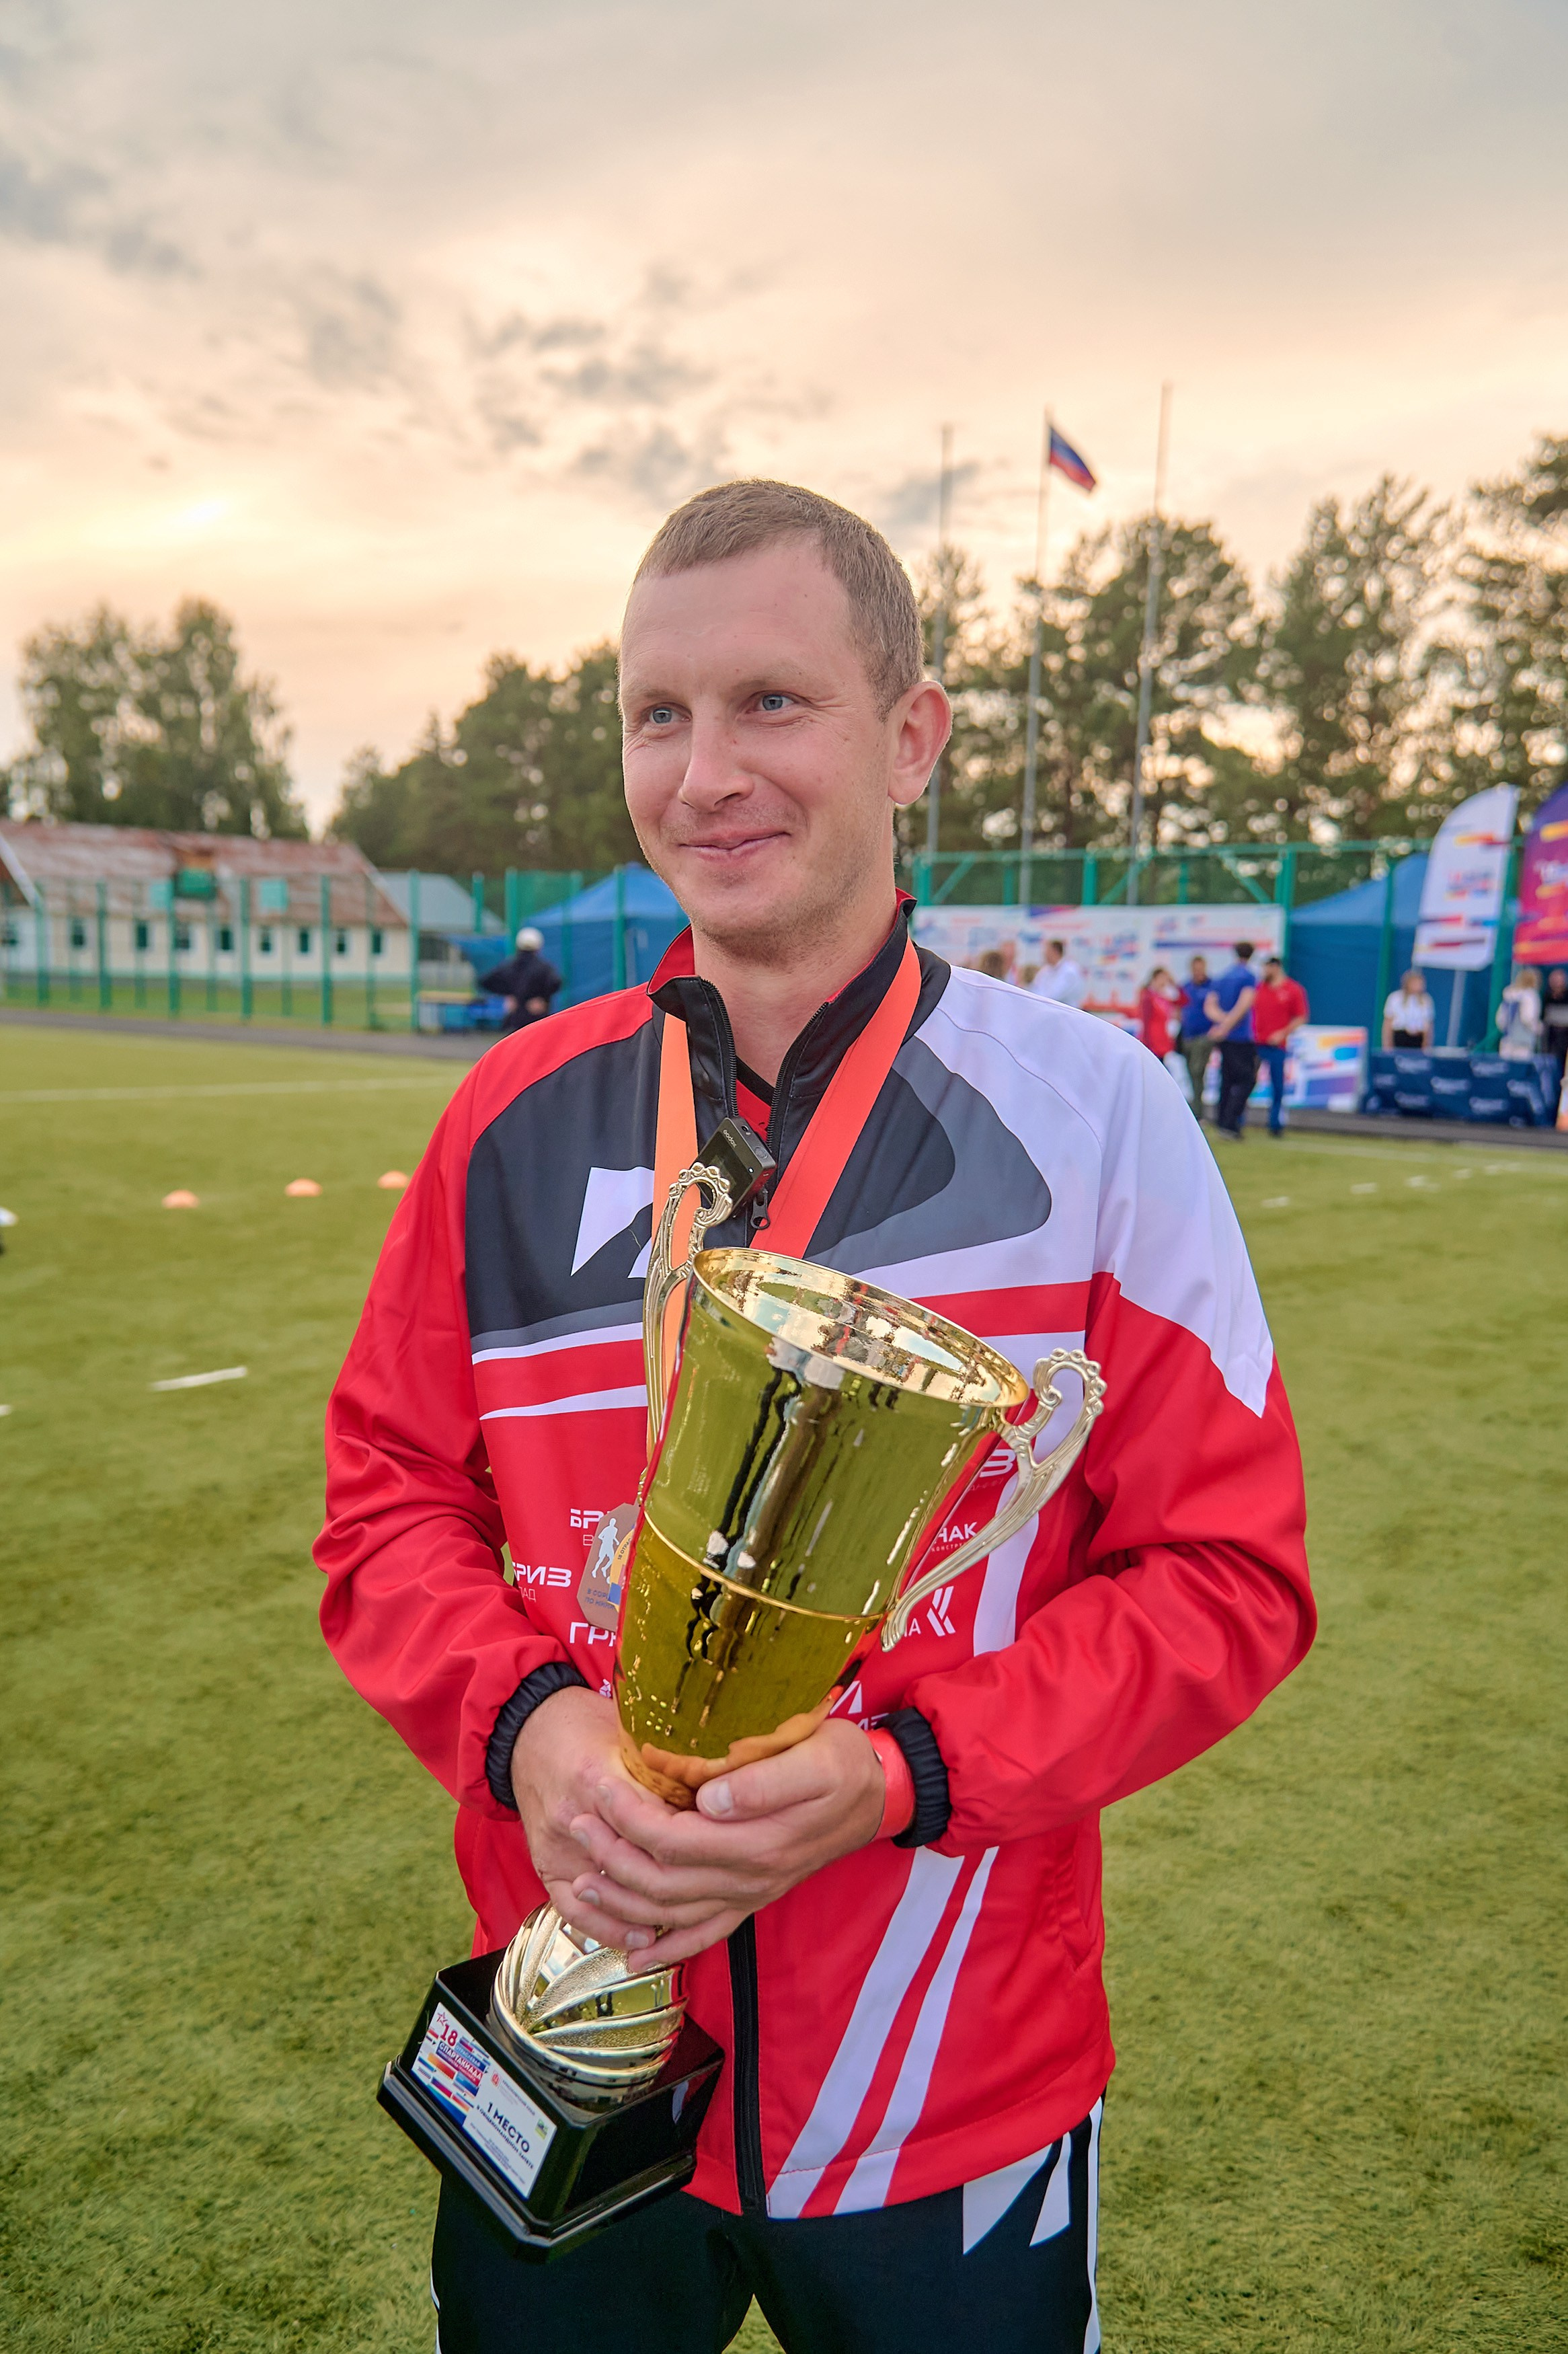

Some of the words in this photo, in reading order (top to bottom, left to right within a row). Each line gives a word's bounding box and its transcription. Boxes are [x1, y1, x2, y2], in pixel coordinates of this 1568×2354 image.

[570, 1508, 611, 1529] БР
[440, 2023, 458, 2047] 18
[438, 2042, 482, 2080] СПАРТАКИАДА
[486, 2101, 494, 2114] 1
[493, 2107, 531, 2154] МЕСТО
